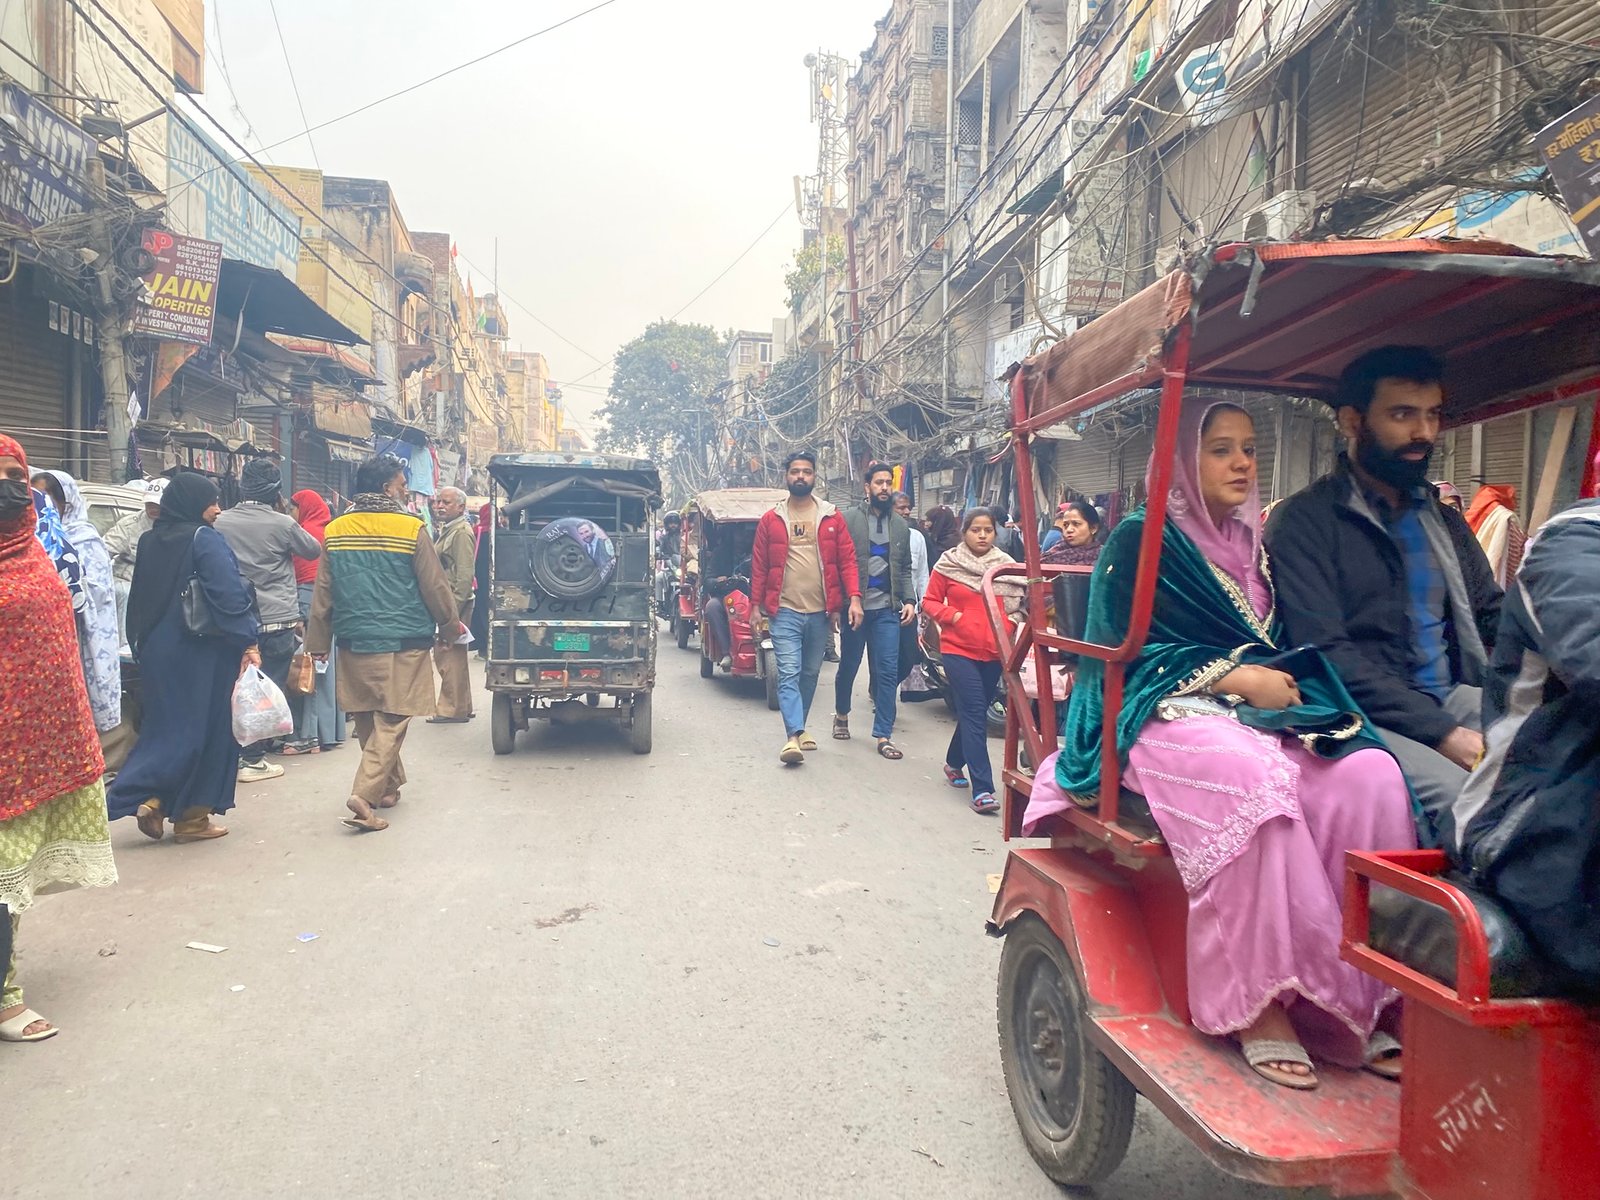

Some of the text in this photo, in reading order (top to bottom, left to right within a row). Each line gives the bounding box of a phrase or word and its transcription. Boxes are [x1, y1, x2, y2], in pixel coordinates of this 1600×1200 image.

[186, 240, 220, 251] SANDEEP
[200, 262, 217, 270] JAIN
[144, 273, 213, 303] JAIN
[169, 312, 210, 328] CONSULTANT
[182, 325, 208, 337] ADVISER
